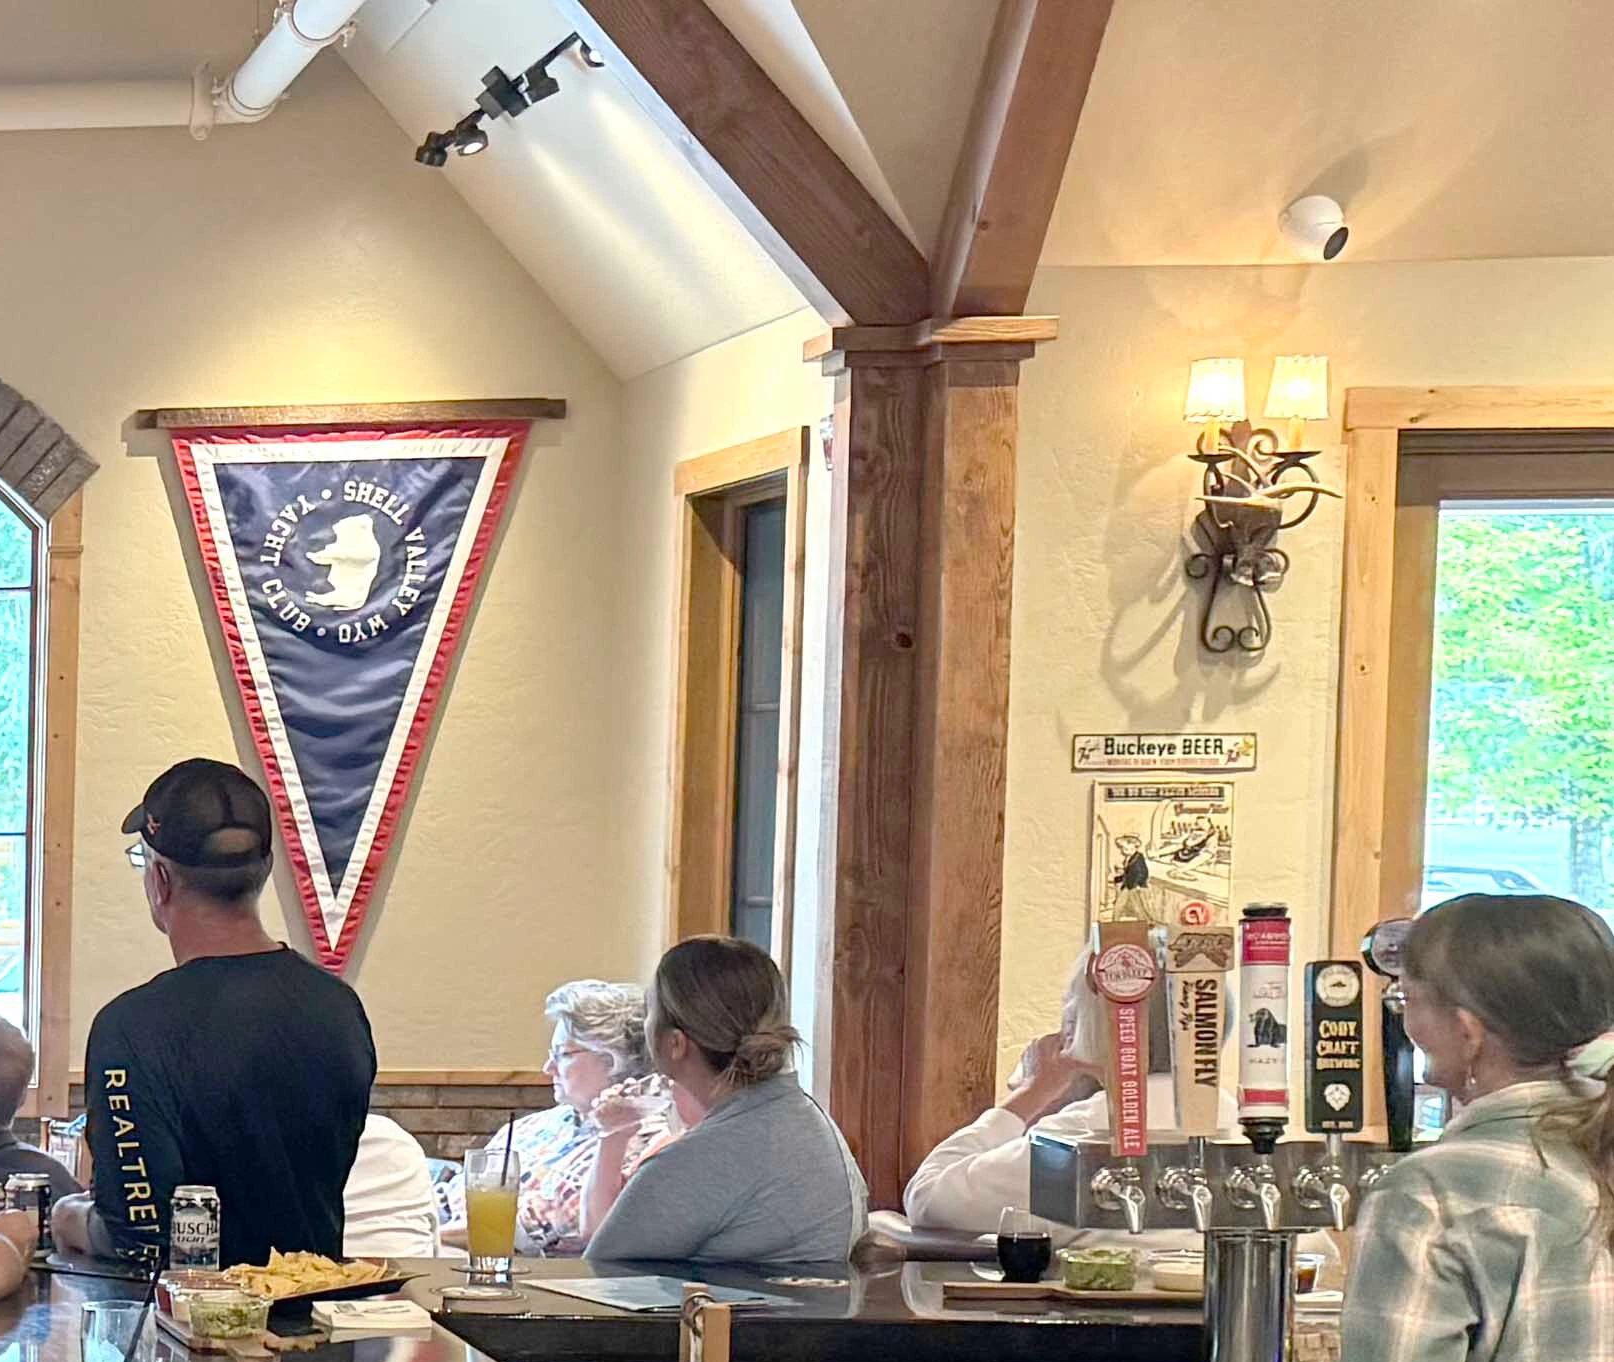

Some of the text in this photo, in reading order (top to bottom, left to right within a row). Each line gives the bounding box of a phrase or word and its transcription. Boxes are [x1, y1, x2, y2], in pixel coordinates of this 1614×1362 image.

[259, 494, 316, 632] YACHT CLUB
[338, 480, 428, 644] SHELL VALLEY WYO
[1104, 735, 1177, 756] Buckeye
[1182, 738, 1224, 756] BEER
[1119, 1007, 1140, 1149] SPEED GOAT GOLDEN ALE
[1195, 978, 1218, 1089] SALMON FLY
[1316, 1039, 1360, 1056] CRAFT
[1319, 1019, 1357, 1038] CODY
